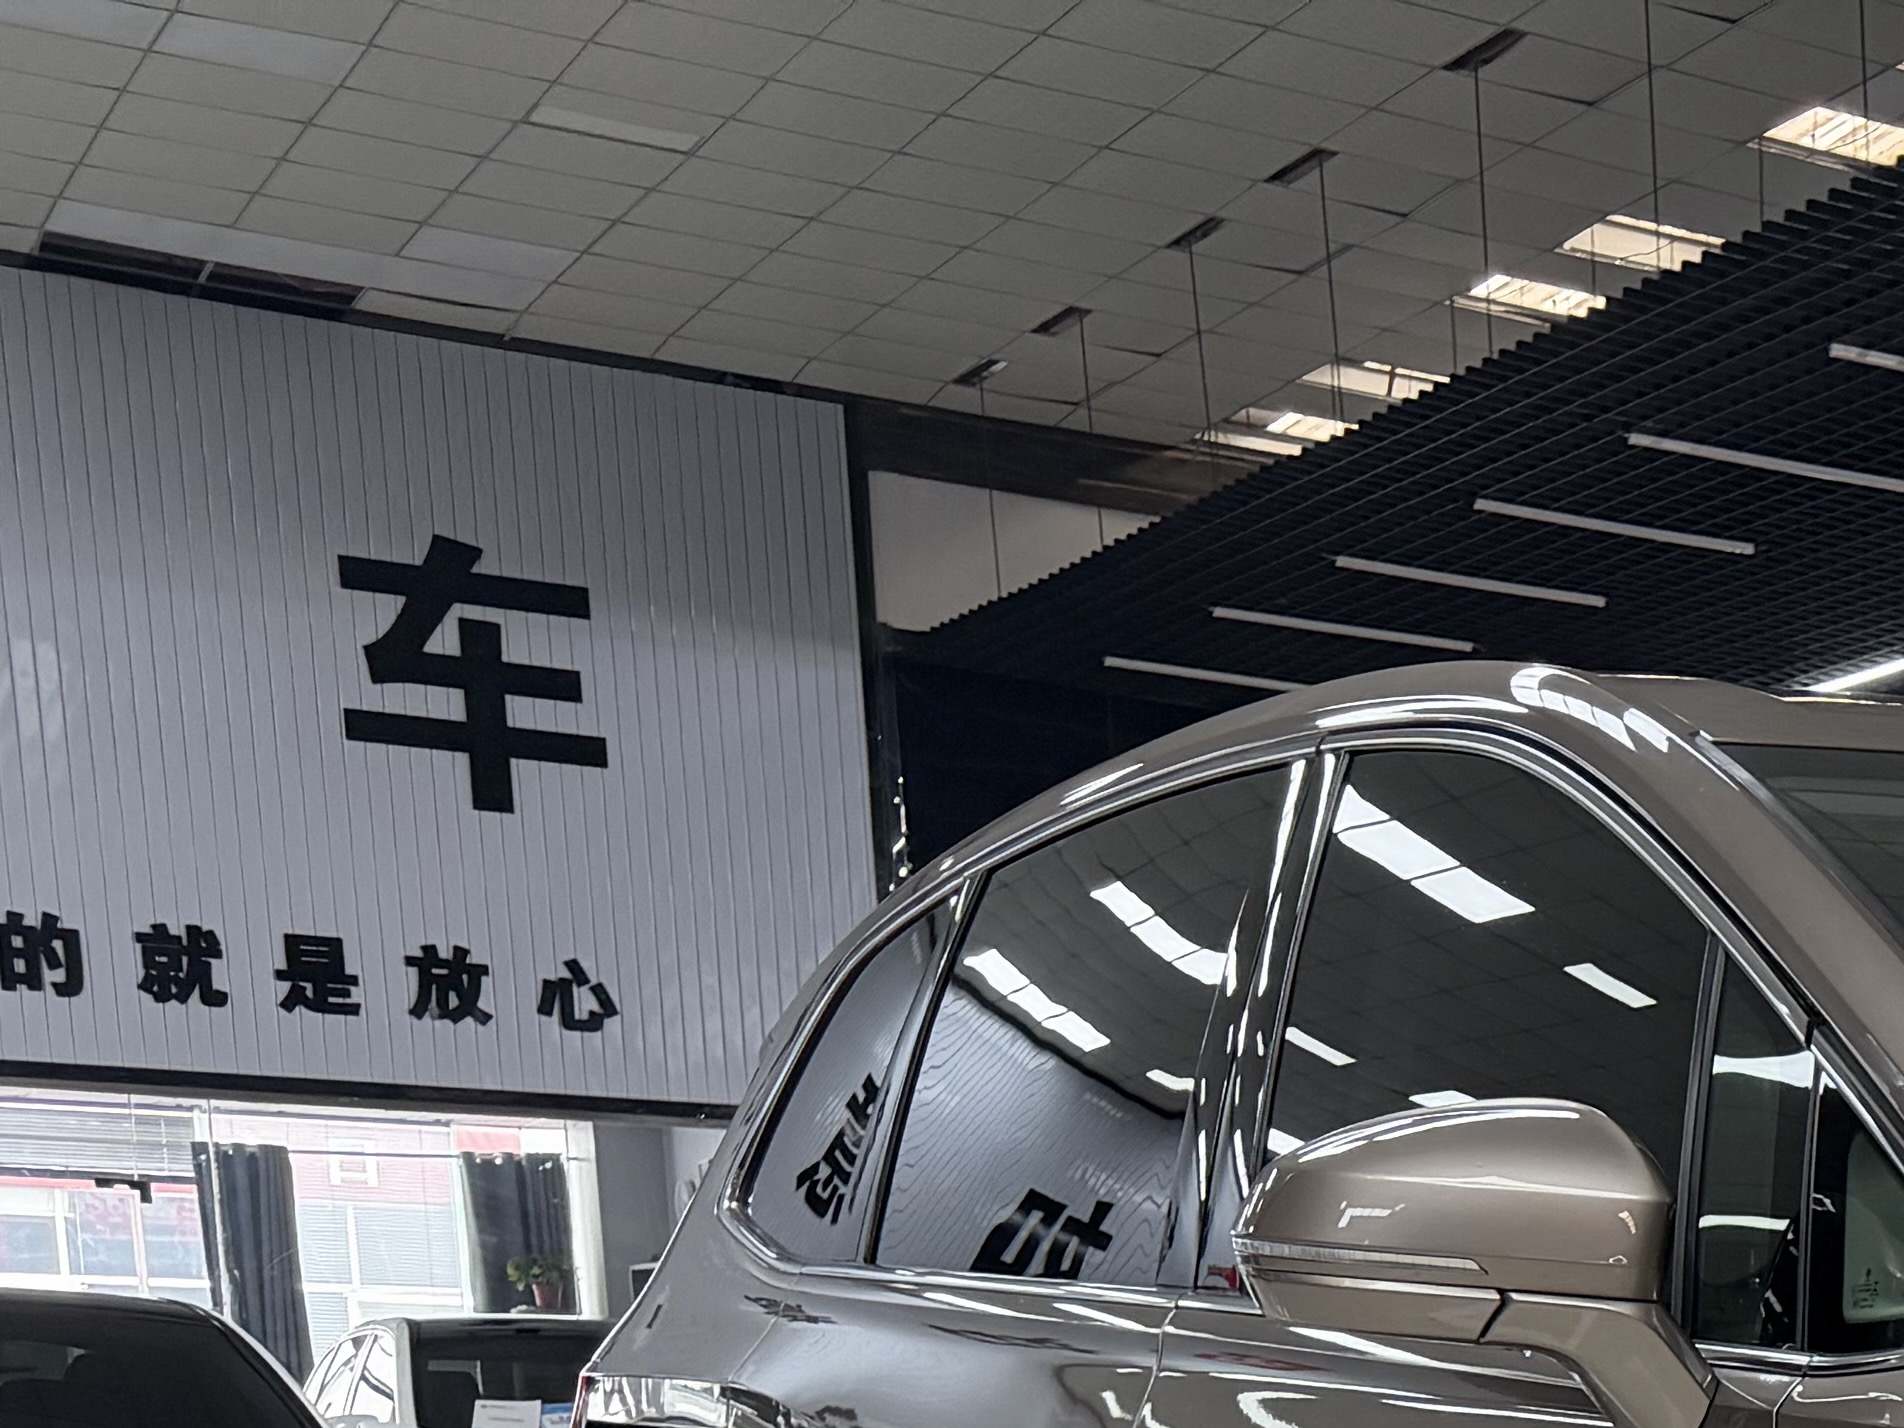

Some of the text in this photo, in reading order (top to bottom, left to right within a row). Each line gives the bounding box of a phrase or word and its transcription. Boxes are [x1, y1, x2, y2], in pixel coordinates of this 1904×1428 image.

[338, 534, 608, 815] 车
[0, 910, 620, 1033] 的就是放心
